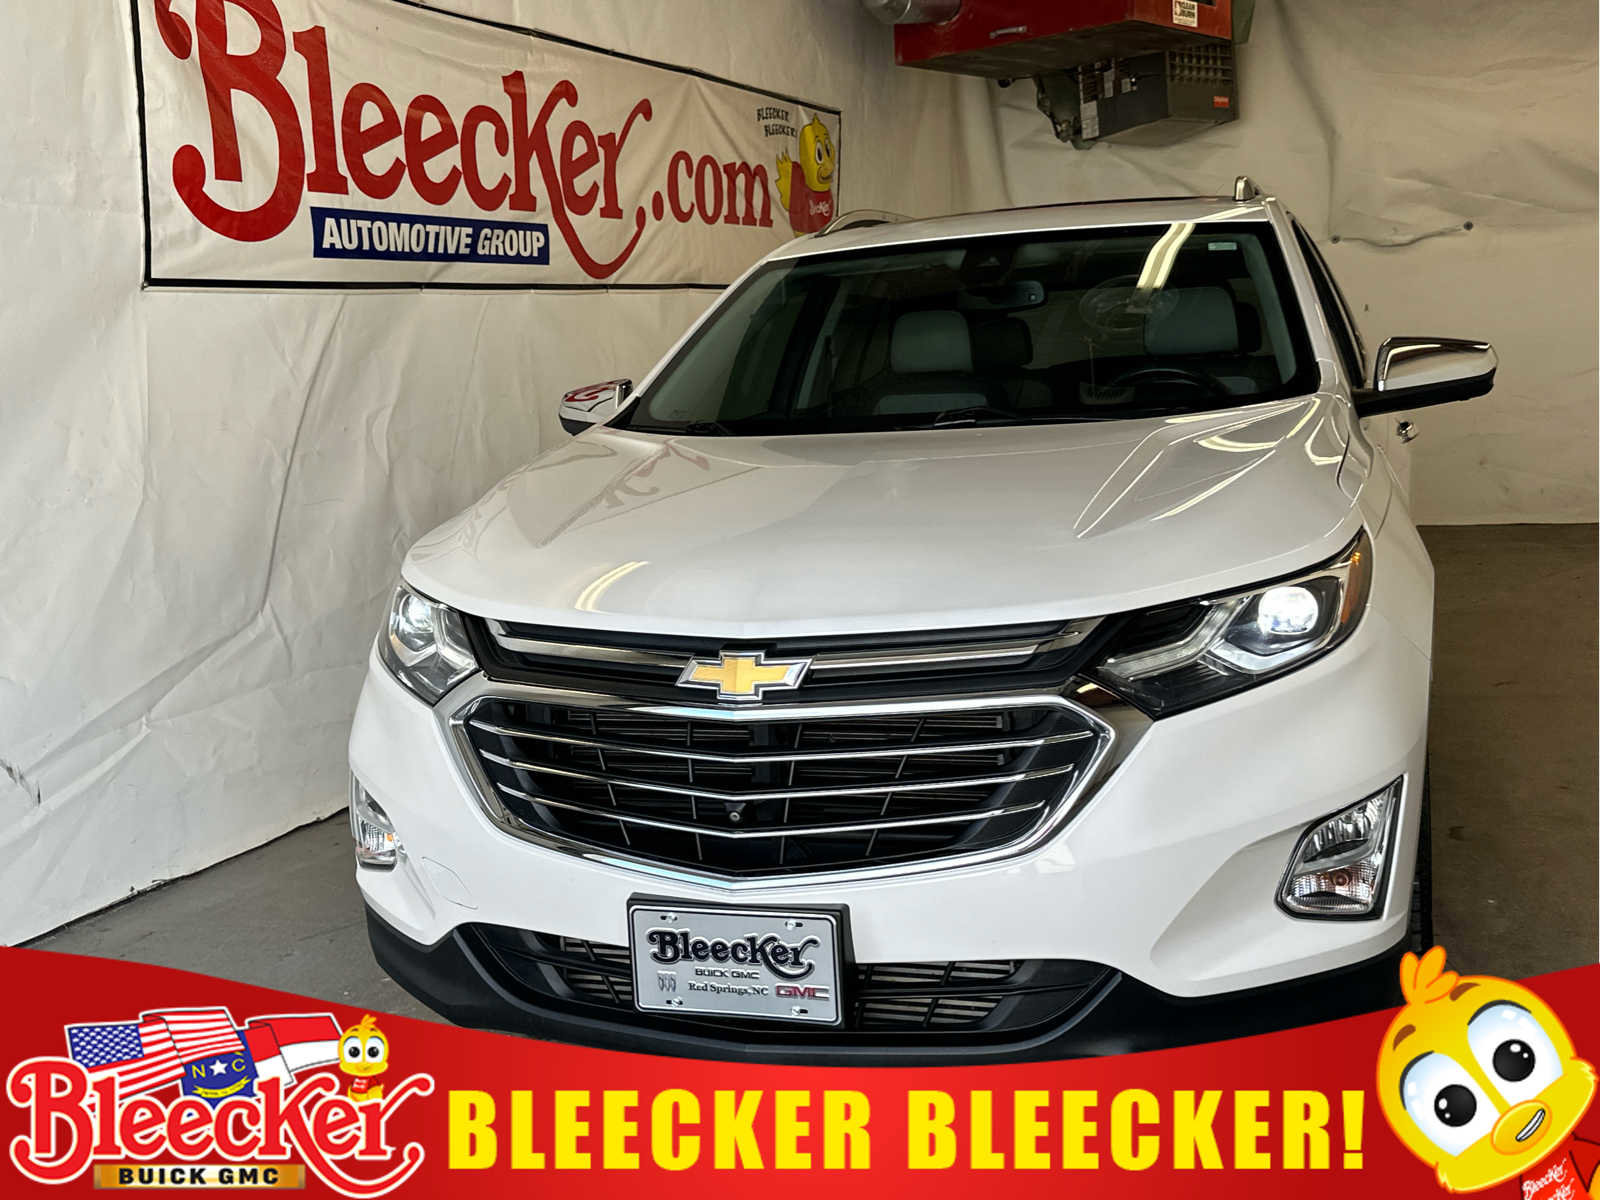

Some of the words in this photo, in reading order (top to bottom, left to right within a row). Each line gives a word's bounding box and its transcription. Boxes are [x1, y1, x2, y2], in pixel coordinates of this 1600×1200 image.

[322, 217, 473, 254] AUTOMOTIVE
[477, 228, 545, 257] GROUP
[647, 929, 822, 982] Bleecker
[695, 967, 729, 978] BUICK
[731, 969, 760, 980] GMC
[688, 982, 708, 992] Red
[776, 984, 830, 1001] GMC
